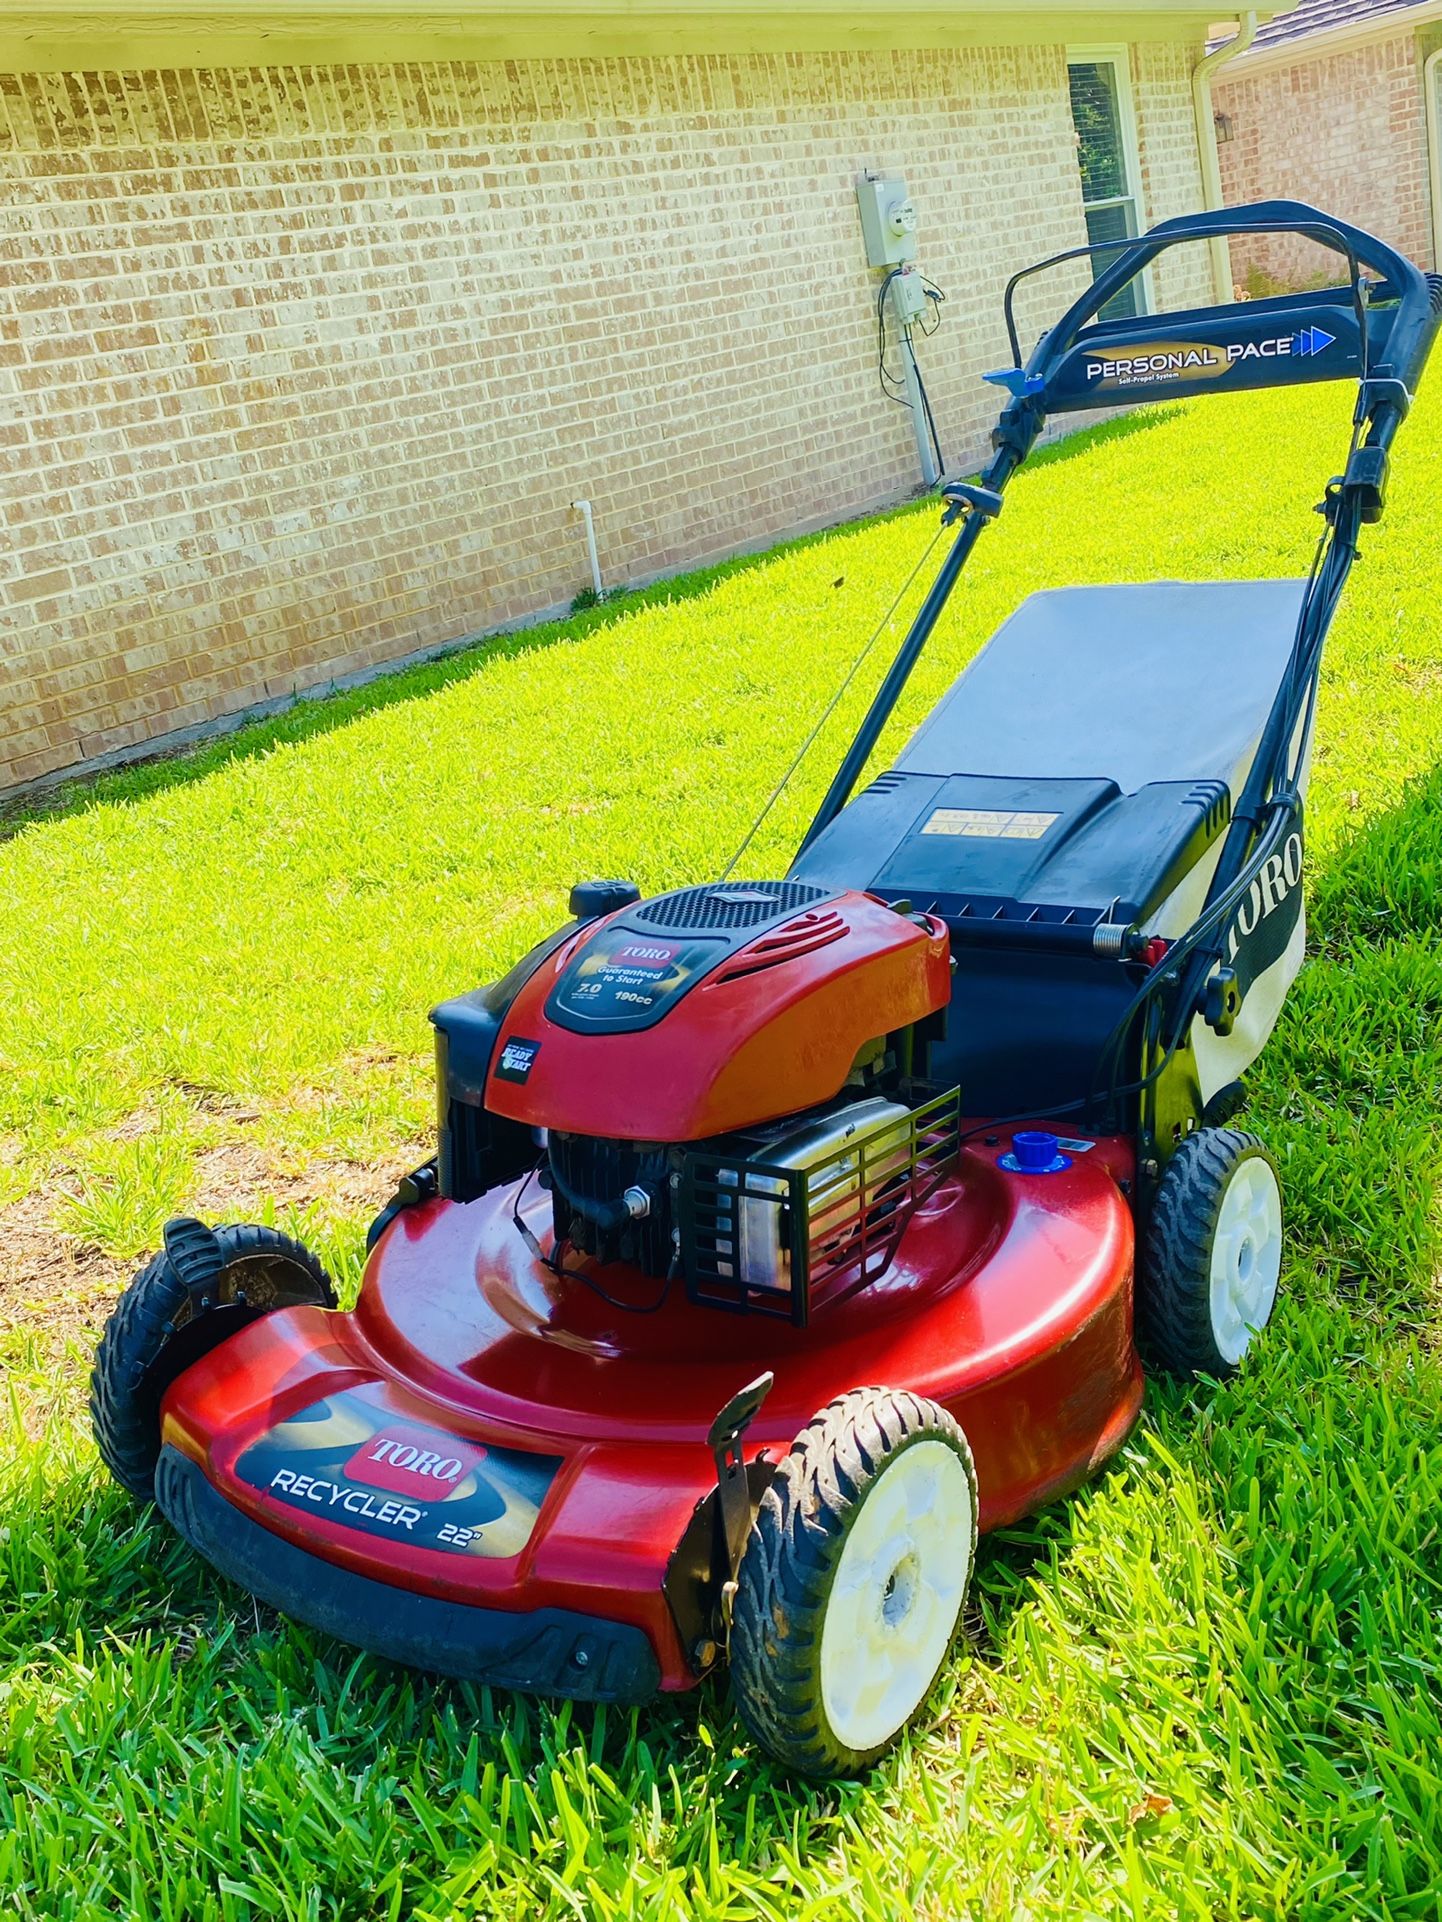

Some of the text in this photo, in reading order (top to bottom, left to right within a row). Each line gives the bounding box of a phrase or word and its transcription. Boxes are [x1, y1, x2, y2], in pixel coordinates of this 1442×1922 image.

[1086, 337, 1294, 380] PERSONAL PACE
[1155, 372, 1179, 381] System
[621, 946, 671, 961] TORO
[598, 966, 663, 980] Guaranteed
[603, 974, 643, 985] to Start
[577, 983, 602, 994] 7.0
[615, 990, 653, 1005] 190cc
